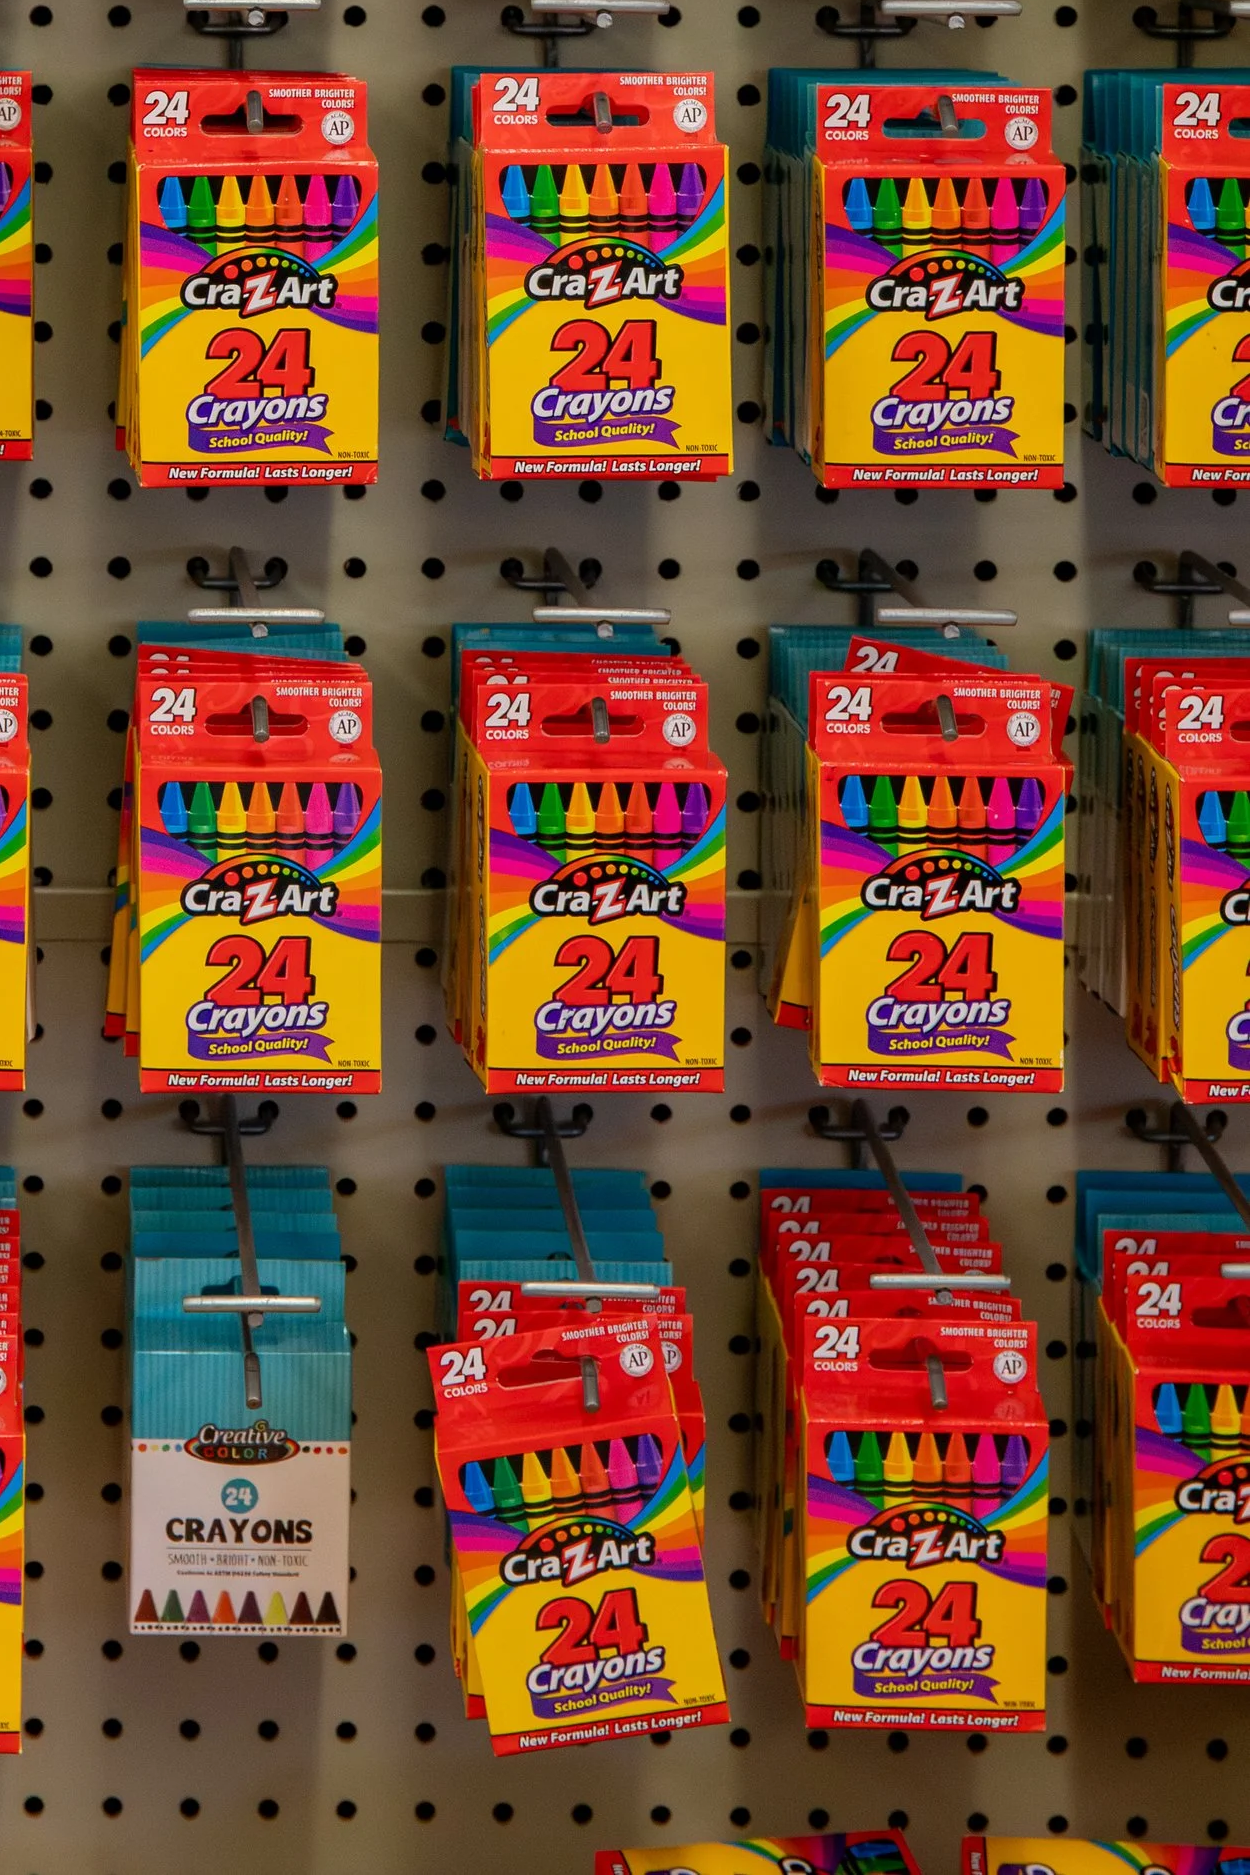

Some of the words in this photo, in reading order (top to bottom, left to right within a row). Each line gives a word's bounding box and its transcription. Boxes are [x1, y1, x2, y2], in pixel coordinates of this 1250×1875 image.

[493, 77, 540, 112] 24
[951, 93, 996, 104] SMOOTHER
[998, 94, 1040, 105] BRIGHTER
[493, 114, 539, 125] COLORS
[1005, 105, 1039, 115] COLORS!
[1173, 92, 1220, 126] 24
[1174, 128, 1219, 139] COLORS
[532, 385, 674, 422] Crayons
[169, 468, 199, 480] New
[200, 467, 260, 480] Formula!
[265, 467, 299, 479] Lasts
[301, 466, 353, 480] Longer!
[275, 686, 319, 697] SMOOTHER
[321, 687, 363, 698] BRIGHTER
[328, 698, 363, 708] COLORS!
[1177, 696, 1224, 729] 24
[1178, 732, 1223, 743] COLORS
[885, 929, 998, 1001] 24
[867, 996, 1009, 1032] Crayons
[556, 1038, 601, 1054] School
[603, 1037, 656, 1051] Quality!
[1136, 1283, 1182, 1316] 24
[1137, 1317, 1181, 1329] COLORS
[813, 1325, 860, 1360] 24
[813, 1361, 859, 1373] COLORS
[199, 1420, 285, 1444] Creative
[224, 1487, 253, 1506] 24
[165, 1518, 313, 1544] CRAYONS
[852, 1642, 993, 1676] Crayons
[519, 1733, 551, 1749] New
[549, 1724, 611, 1745] Formula!
[614, 1719, 649, 1735] Lasts
[650, 1711, 702, 1729] Longer!
